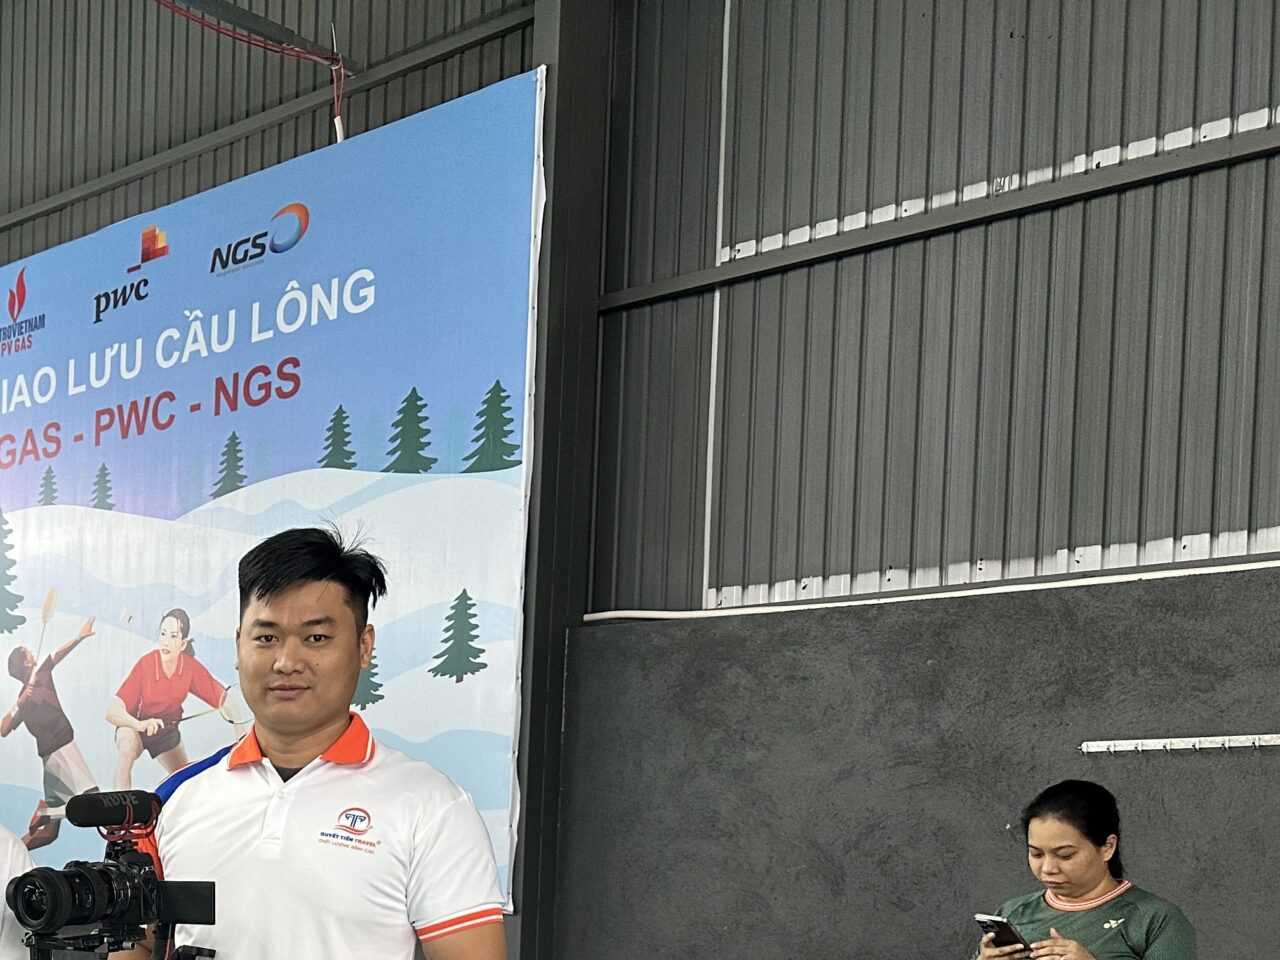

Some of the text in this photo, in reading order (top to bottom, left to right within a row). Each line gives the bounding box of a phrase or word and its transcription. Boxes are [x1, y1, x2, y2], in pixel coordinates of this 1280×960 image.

[210, 231, 268, 273] NGS
[93, 278, 149, 323] pwc
[14, 335, 32, 353] GAS
[69, 338, 143, 396] LƯU
[156, 310, 236, 367] CẦU
[251, 268, 377, 343] LÔNG
[94, 390, 176, 446] PWC
[213, 356, 302, 416] NGS
